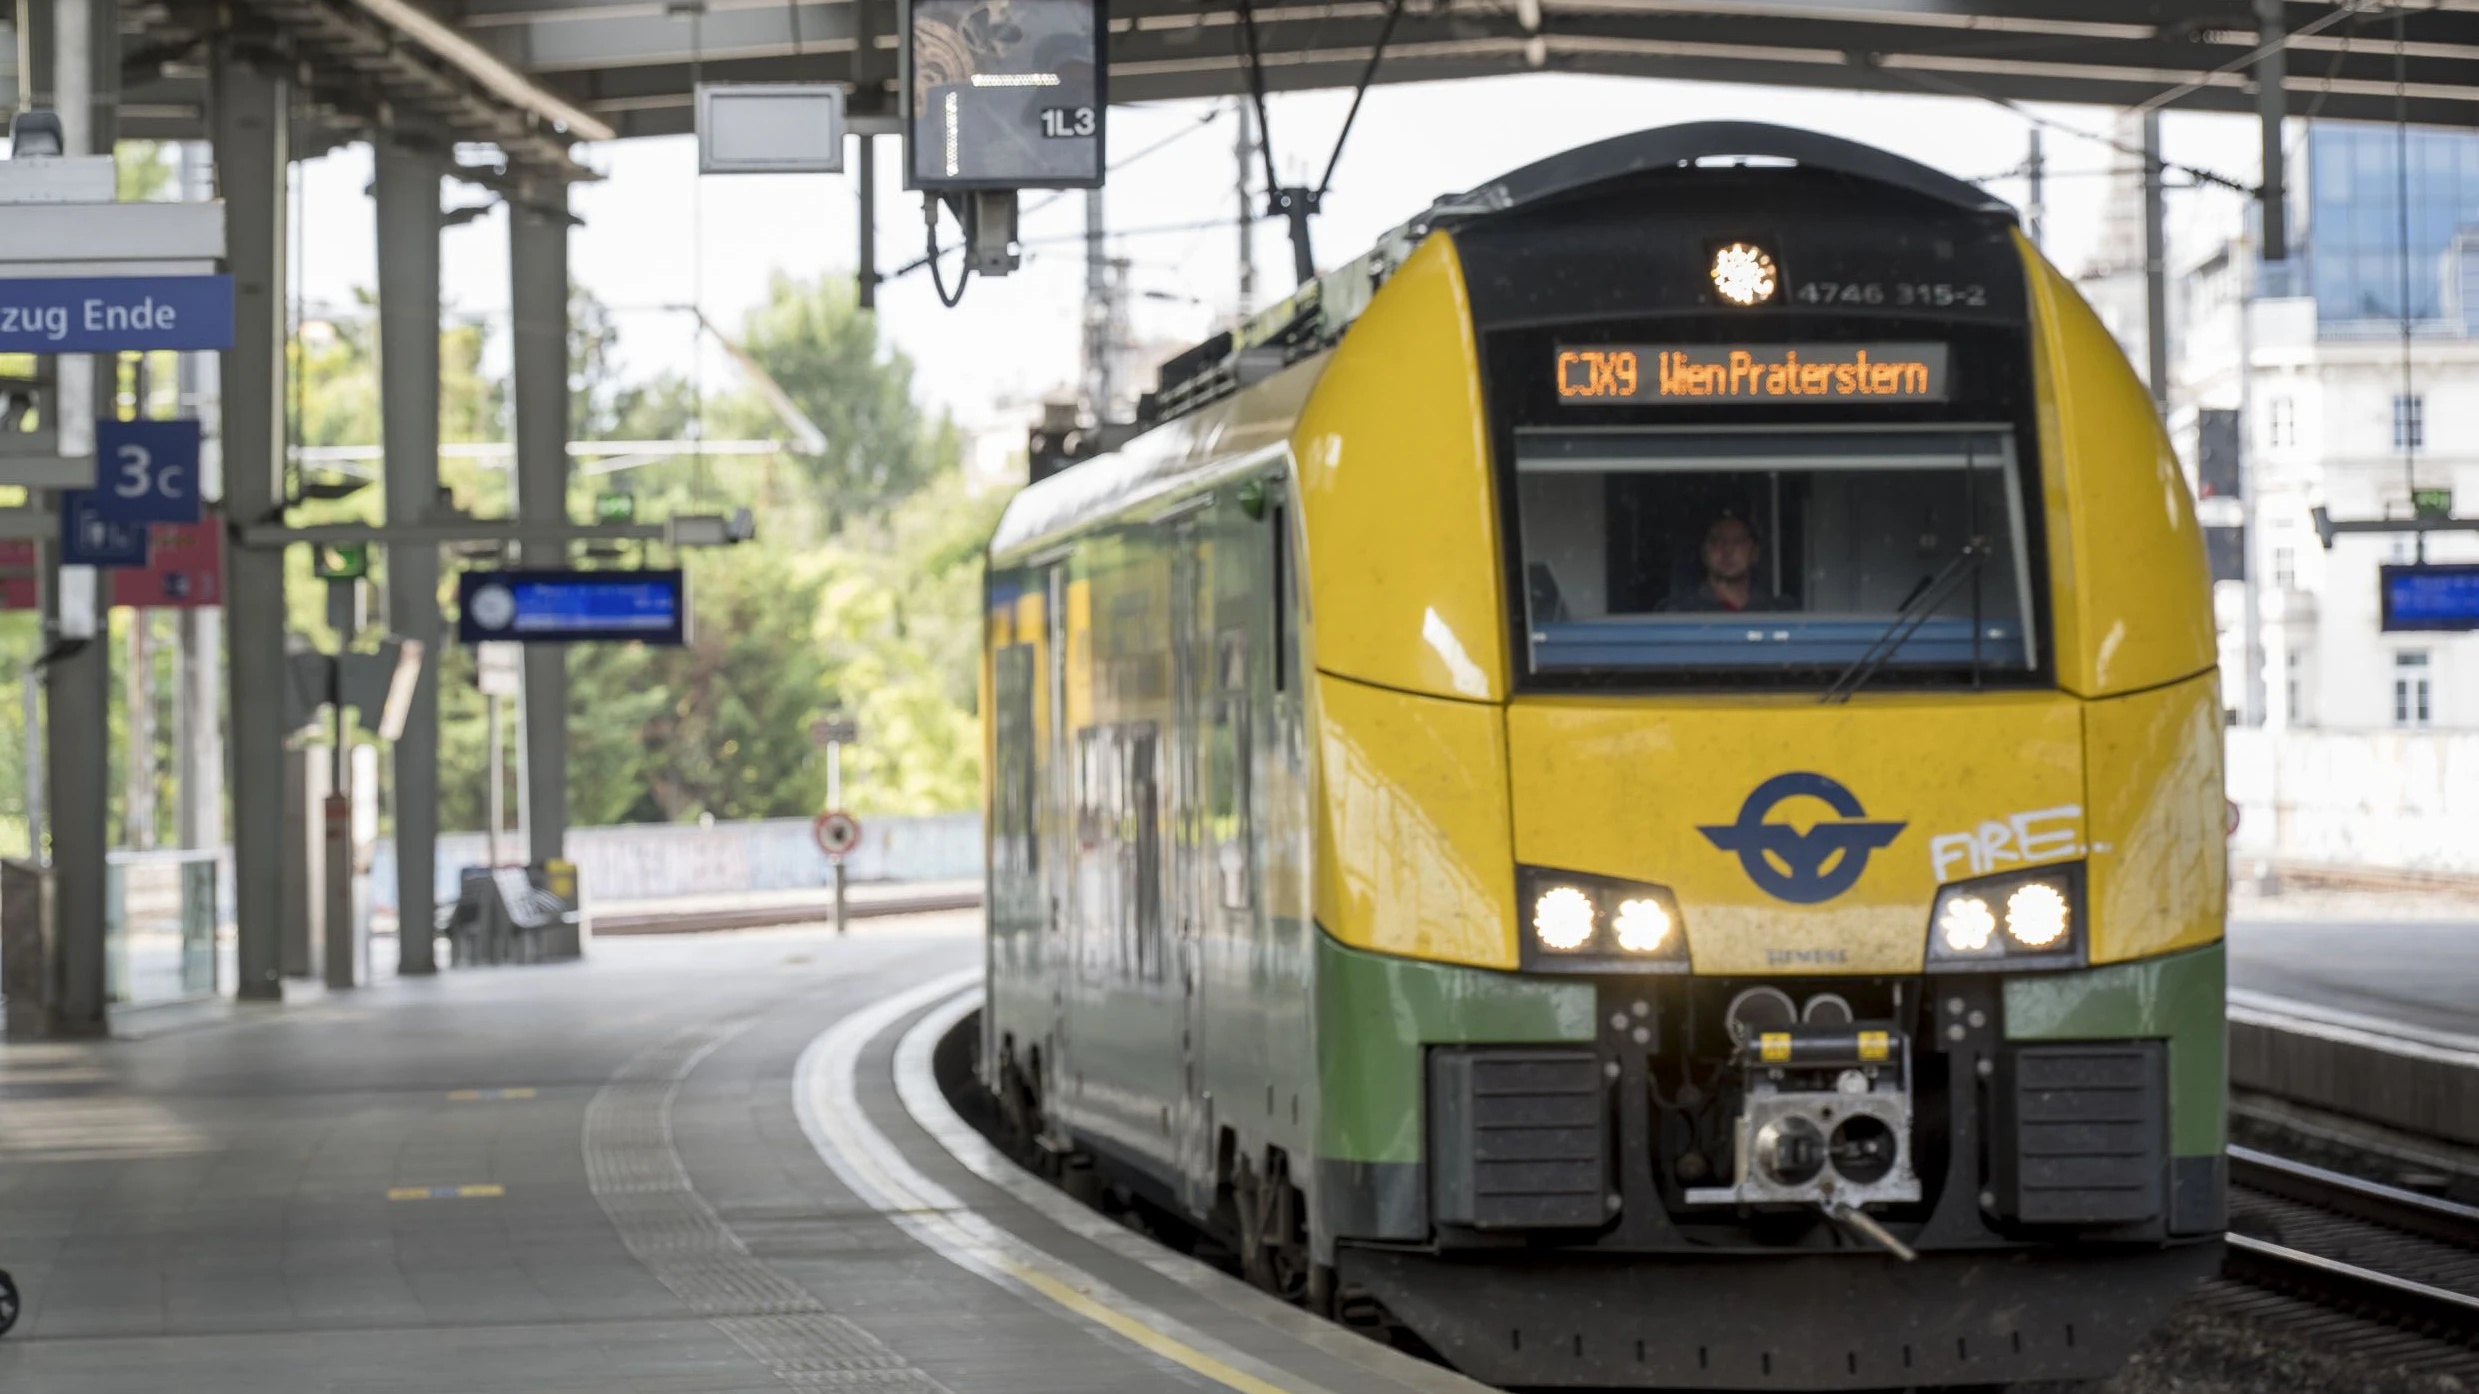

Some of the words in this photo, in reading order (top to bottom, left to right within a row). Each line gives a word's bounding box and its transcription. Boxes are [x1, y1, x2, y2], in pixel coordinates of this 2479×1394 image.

[1040, 107, 1096, 137] 1L3
[1798, 282, 1884, 304] 4746
[1896, 283, 1986, 306] 315-2
[83, 296, 177, 331] Ende
[1557, 351, 1638, 396] CJX9
